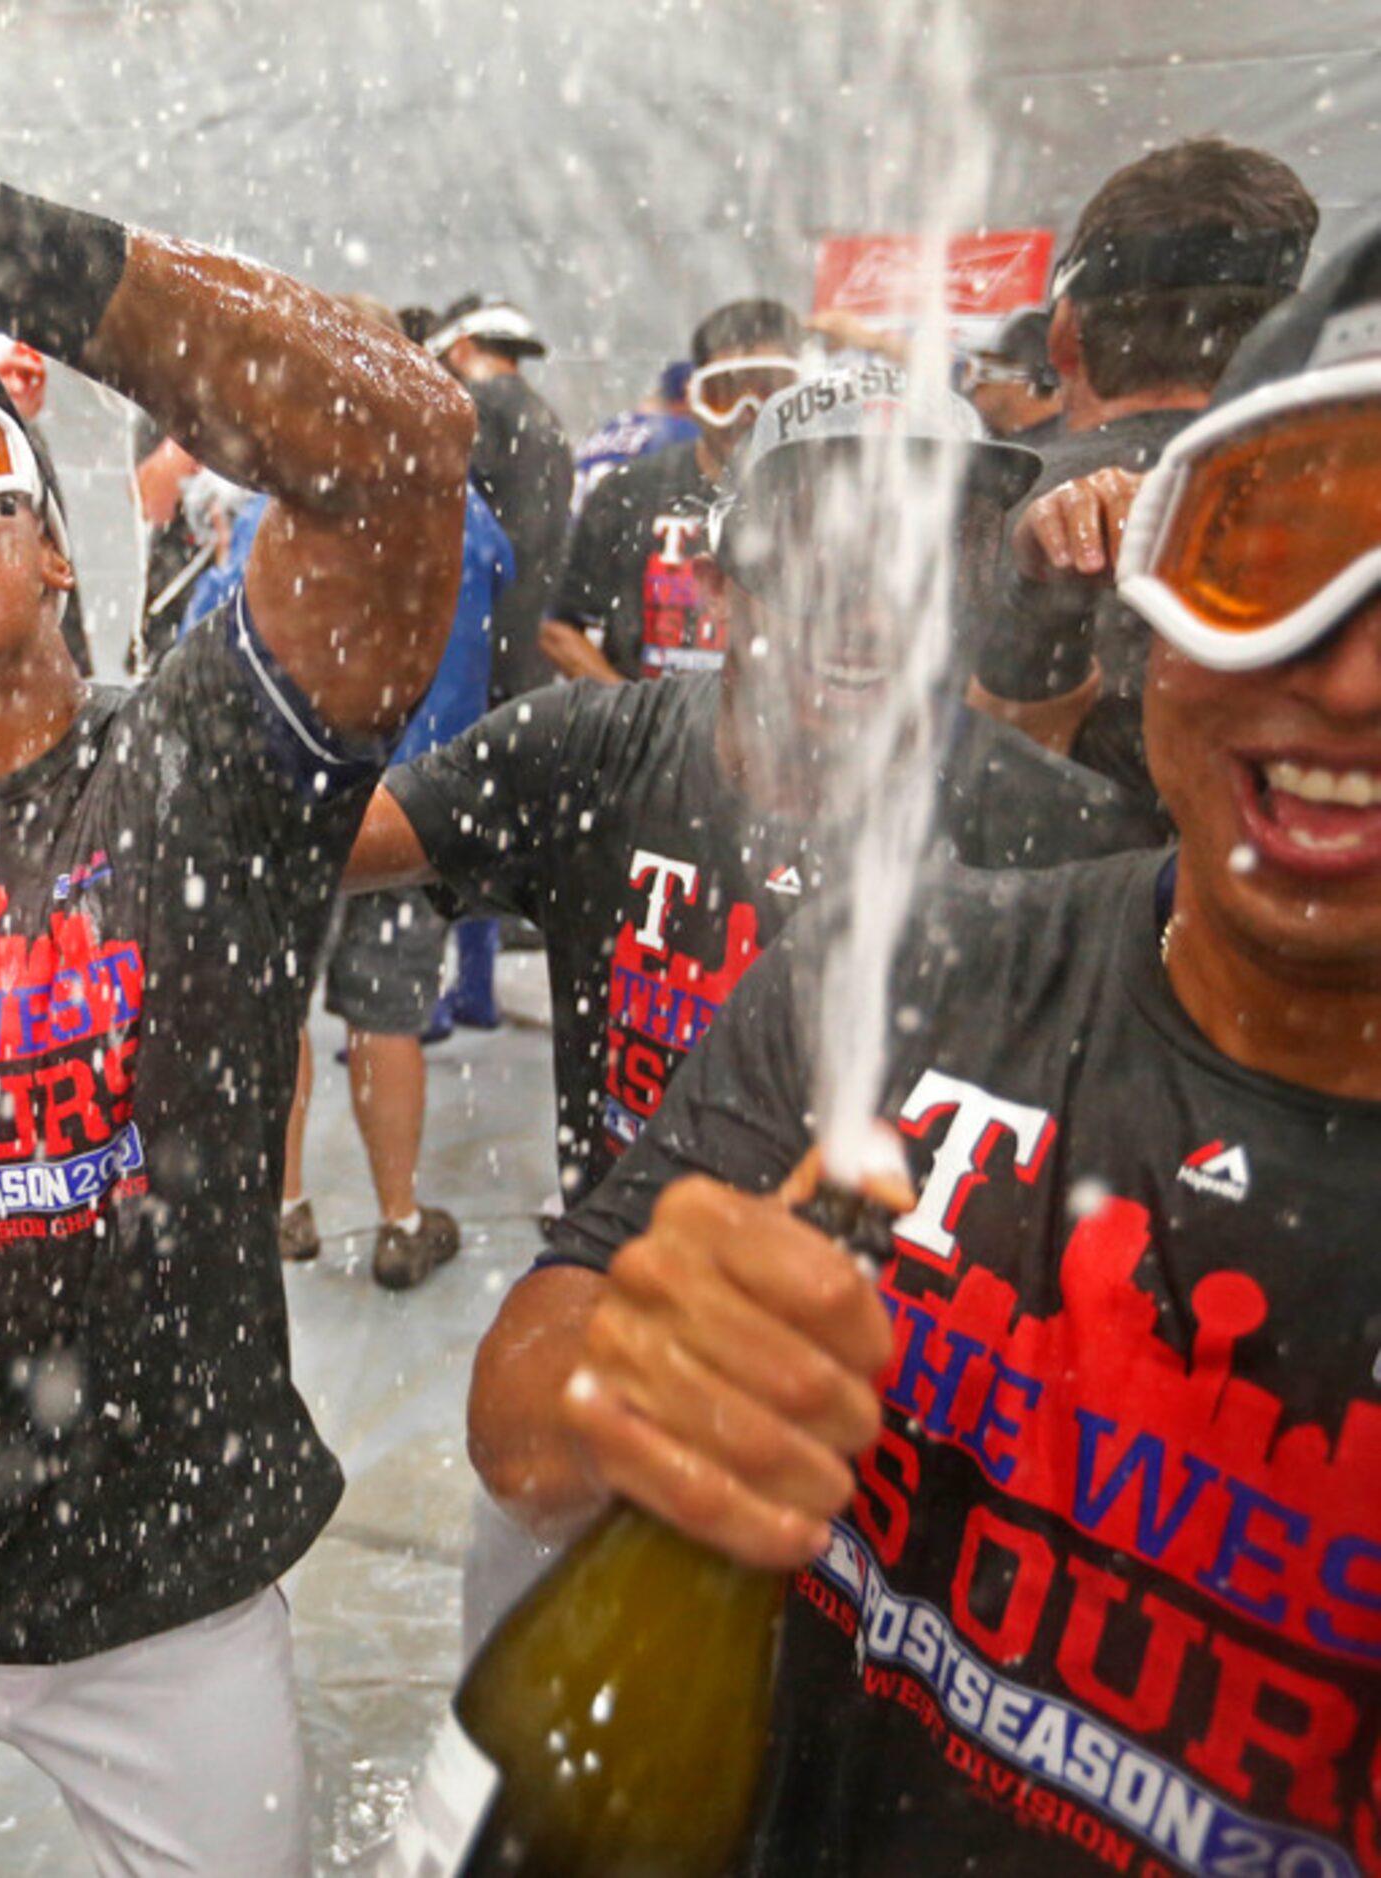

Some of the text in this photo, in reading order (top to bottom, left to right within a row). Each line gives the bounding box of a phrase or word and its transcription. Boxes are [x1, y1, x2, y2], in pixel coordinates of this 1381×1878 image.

[652, 515, 700, 564] T
[629, 850, 698, 951] T
[892, 1068, 1056, 1274] T
[862, 1565, 1216, 1866] POSTSEASON
[944, 1732, 1135, 1872] DIVISION
